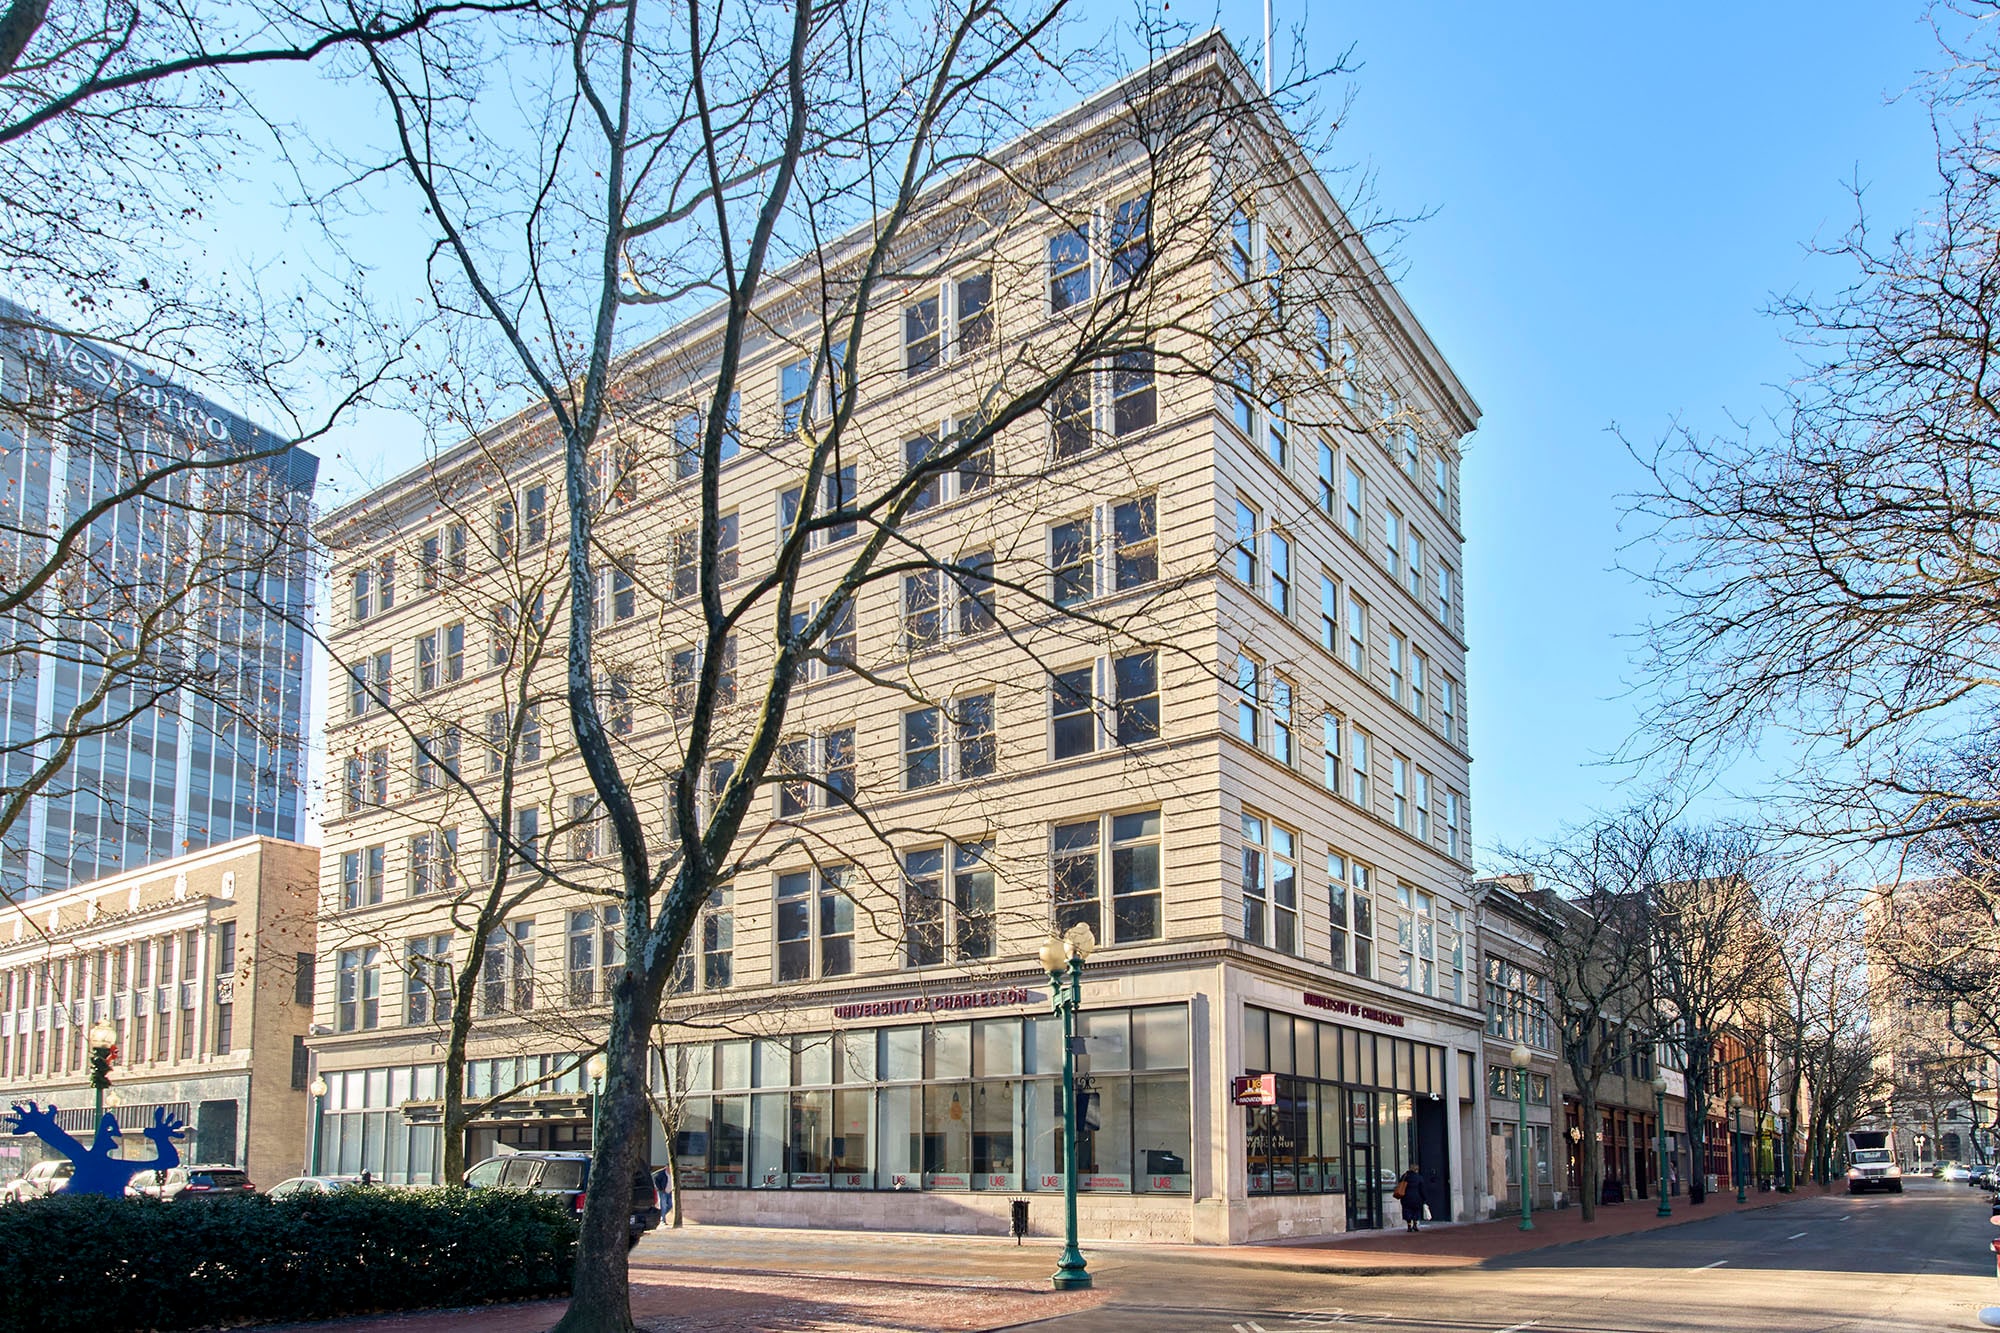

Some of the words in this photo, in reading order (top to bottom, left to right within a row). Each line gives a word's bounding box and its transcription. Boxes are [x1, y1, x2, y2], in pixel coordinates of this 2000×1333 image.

[29, 316, 229, 441] WesBanco
[833, 1000, 908, 1018] UNIVERSITY
[912, 998, 929, 1012] OF
[933, 988, 1028, 1011] CHARLESTON
[989, 1175, 1005, 1187] UC
[1041, 1175, 1058, 1188] UC
